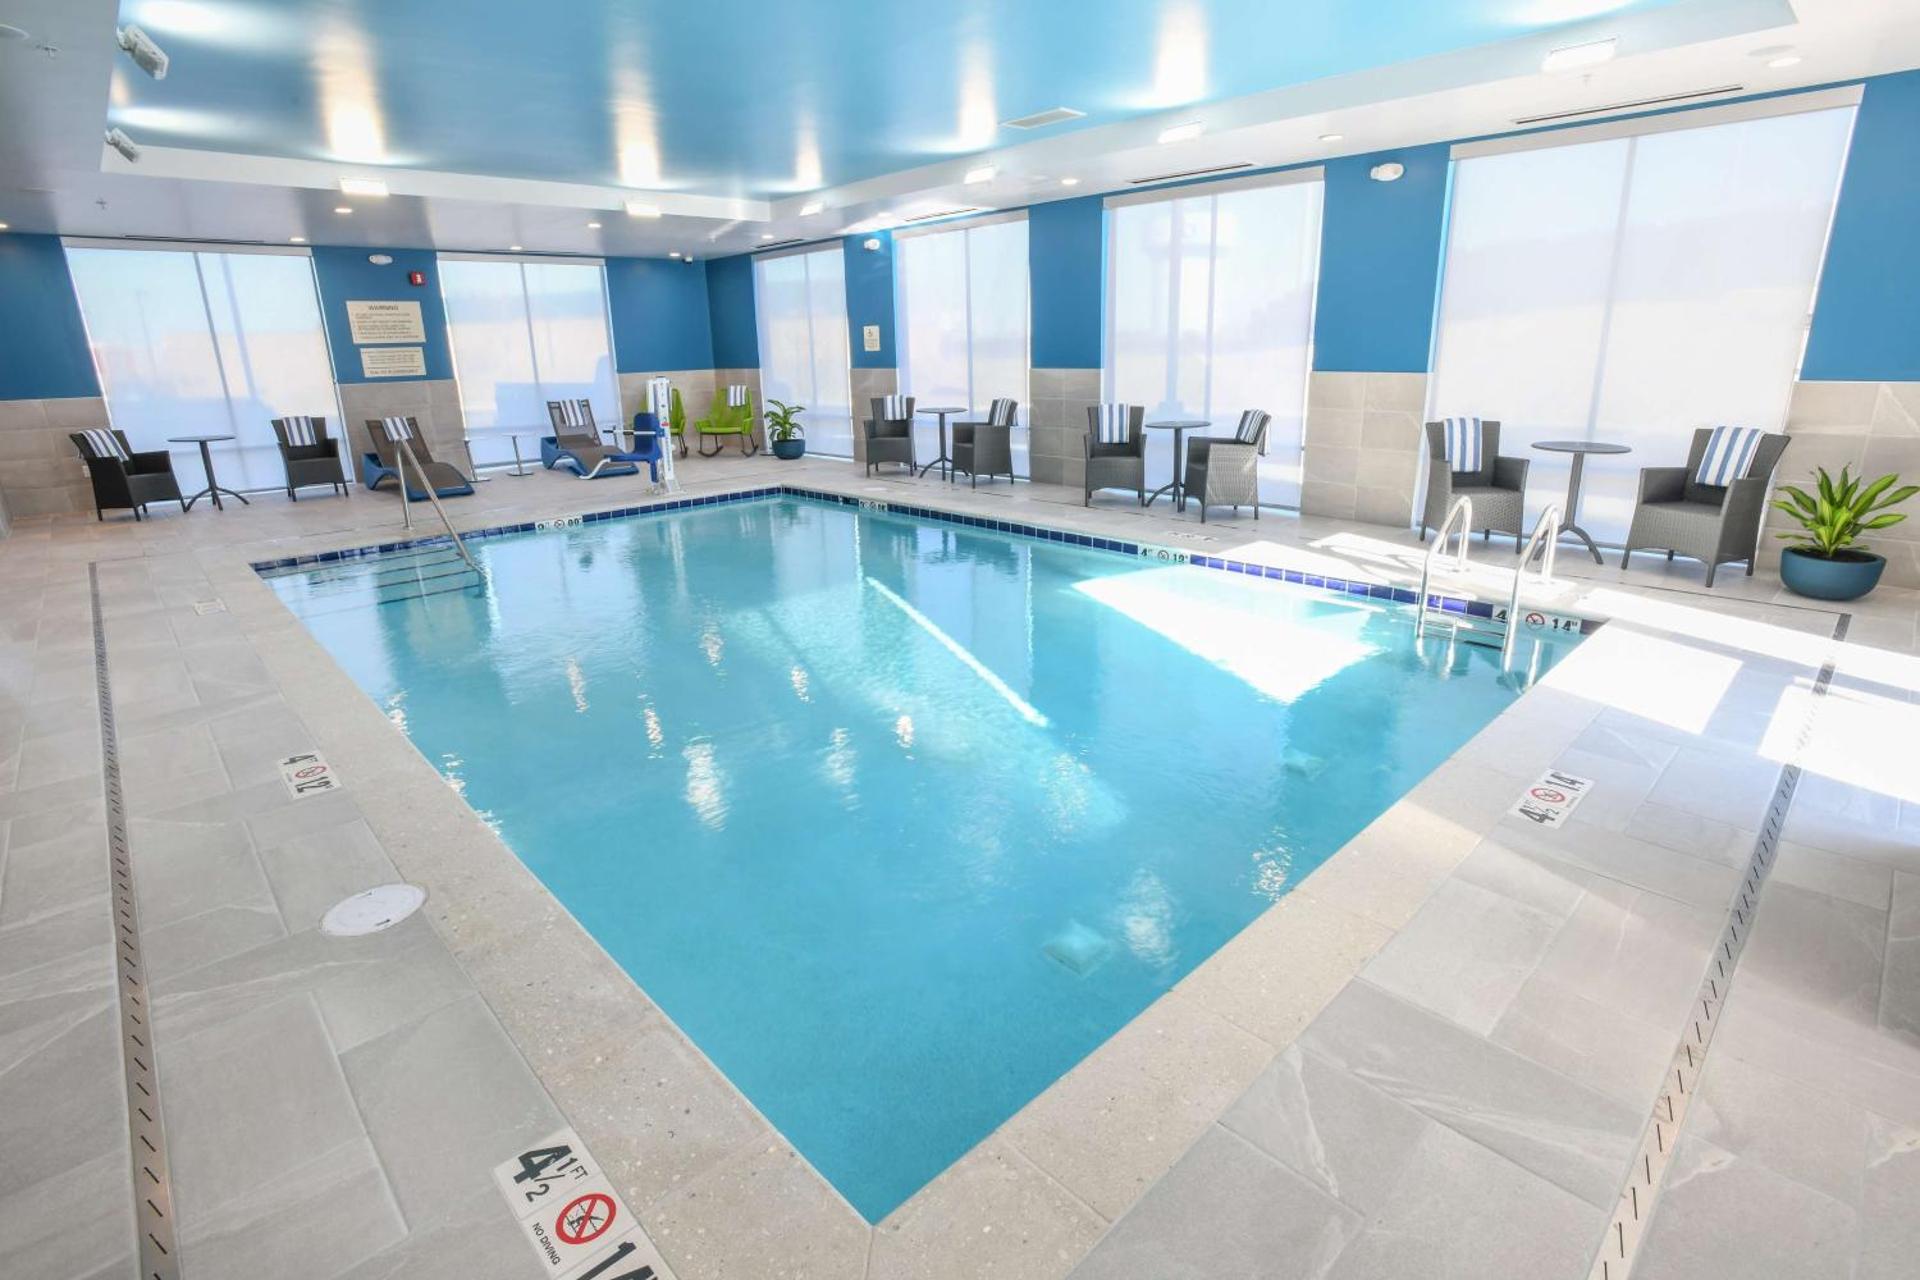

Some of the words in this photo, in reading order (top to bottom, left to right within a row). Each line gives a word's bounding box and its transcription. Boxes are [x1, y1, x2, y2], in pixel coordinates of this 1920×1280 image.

[570, 1165, 588, 1180] FT
[532, 1222, 545, 1237] NO
[540, 1235, 561, 1266] DIVING
